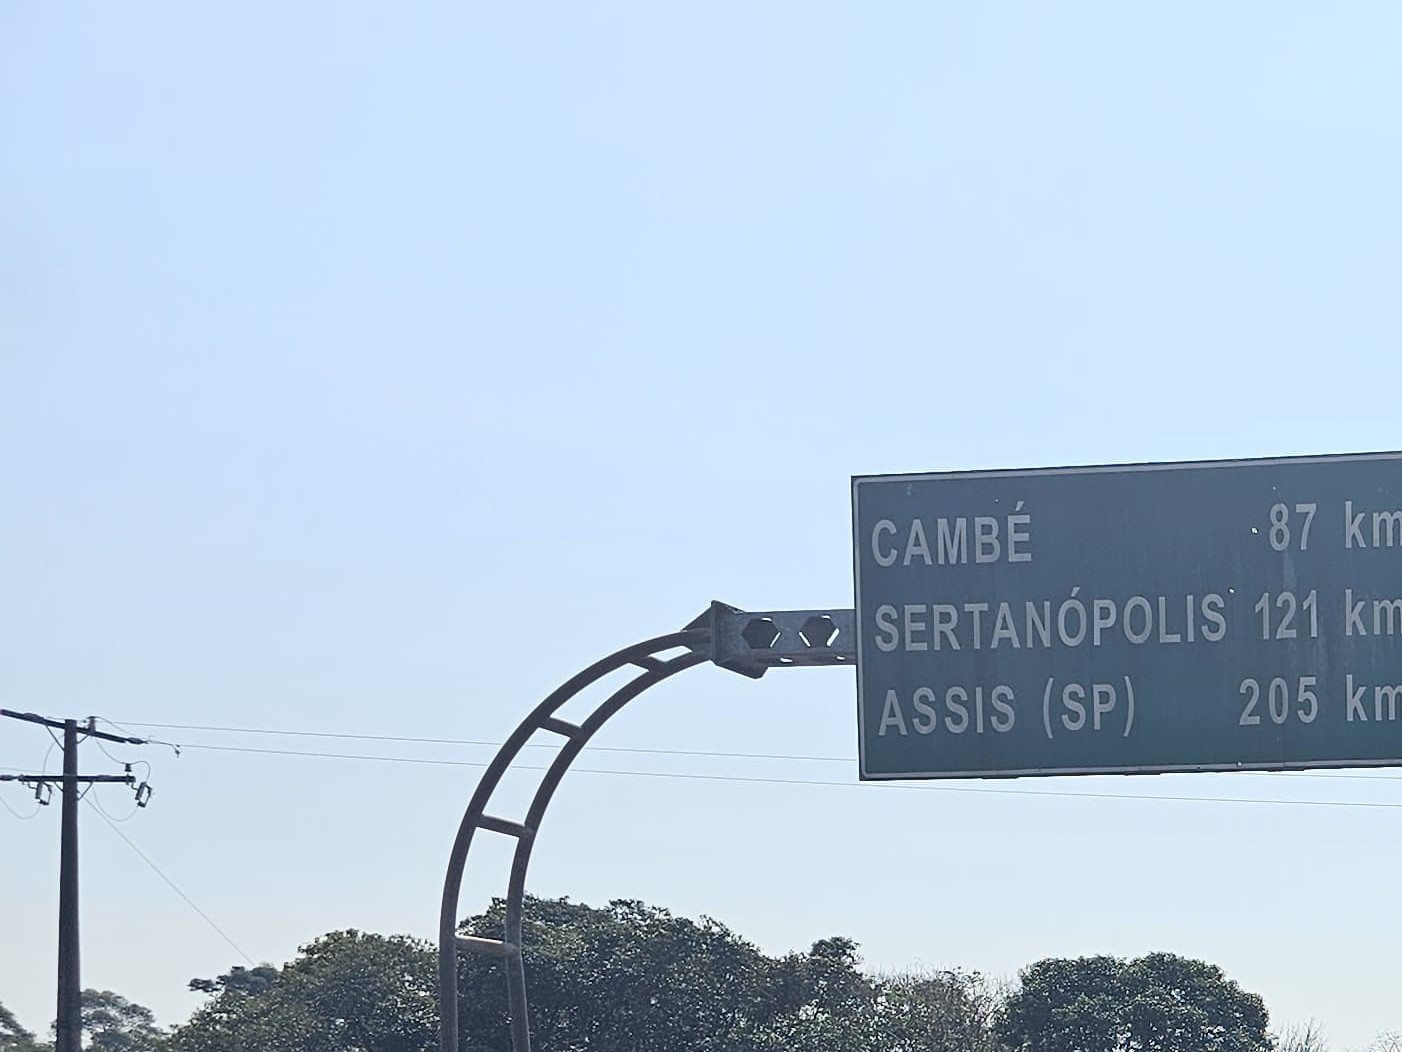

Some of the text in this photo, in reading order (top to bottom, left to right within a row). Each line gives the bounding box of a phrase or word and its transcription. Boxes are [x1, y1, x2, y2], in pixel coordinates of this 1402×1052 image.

[871, 501, 1033, 567] CAMBÉ
[1268, 503, 1318, 551] 87
[874, 587, 1226, 652] SERTANÓPOLIS
[1254, 590, 1318, 640] 121
[878, 686, 1015, 737] ASSIS
[1043, 676, 1135, 739] (SP)
[1239, 677, 1318, 726] 205
